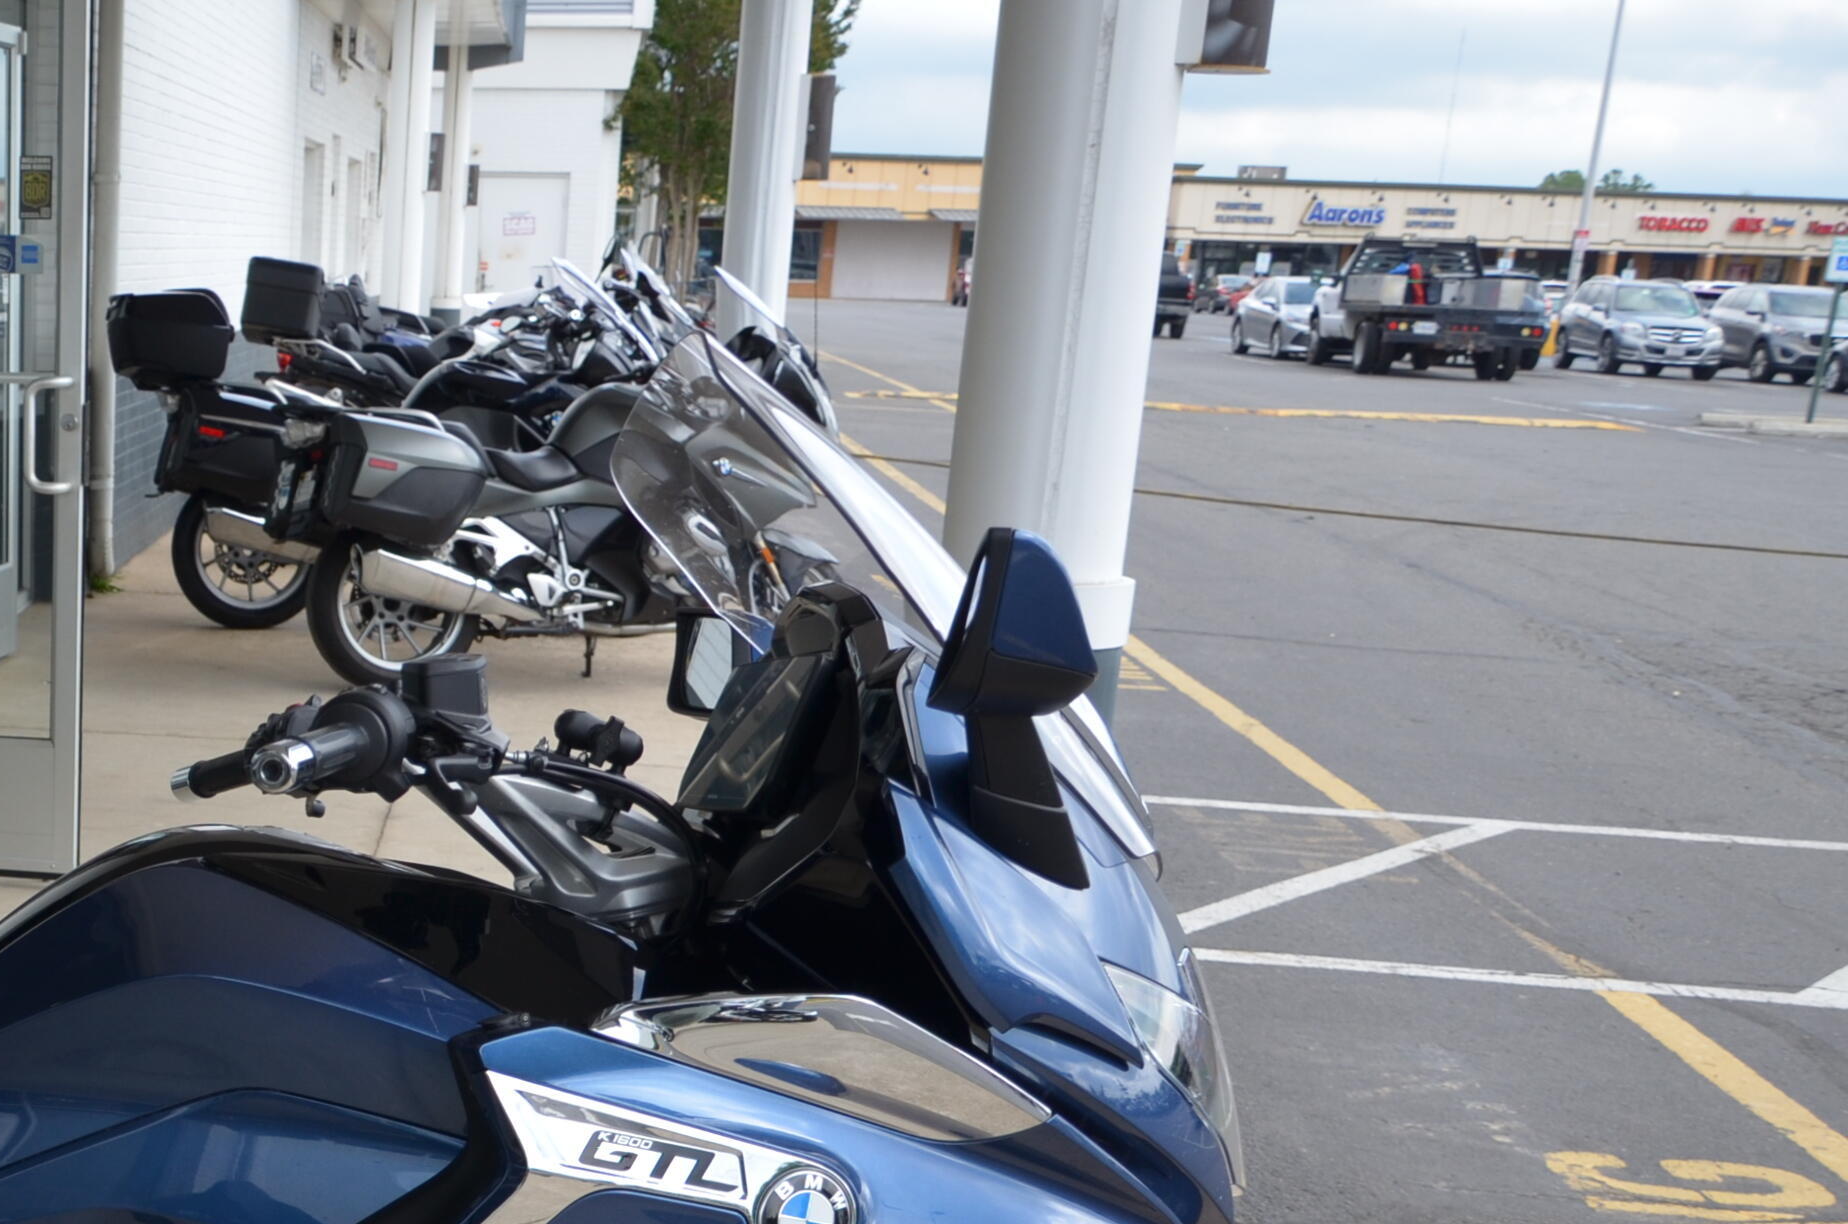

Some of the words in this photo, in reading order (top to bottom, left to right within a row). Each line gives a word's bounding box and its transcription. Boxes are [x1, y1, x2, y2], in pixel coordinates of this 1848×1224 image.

[1638, 216, 1710, 233] TOBACCO
[597, 1131, 614, 1146] K
[613, 1133, 653, 1150] 1600
[578, 1130, 739, 1192] GTL
[774, 1173, 848, 1210] BMW
